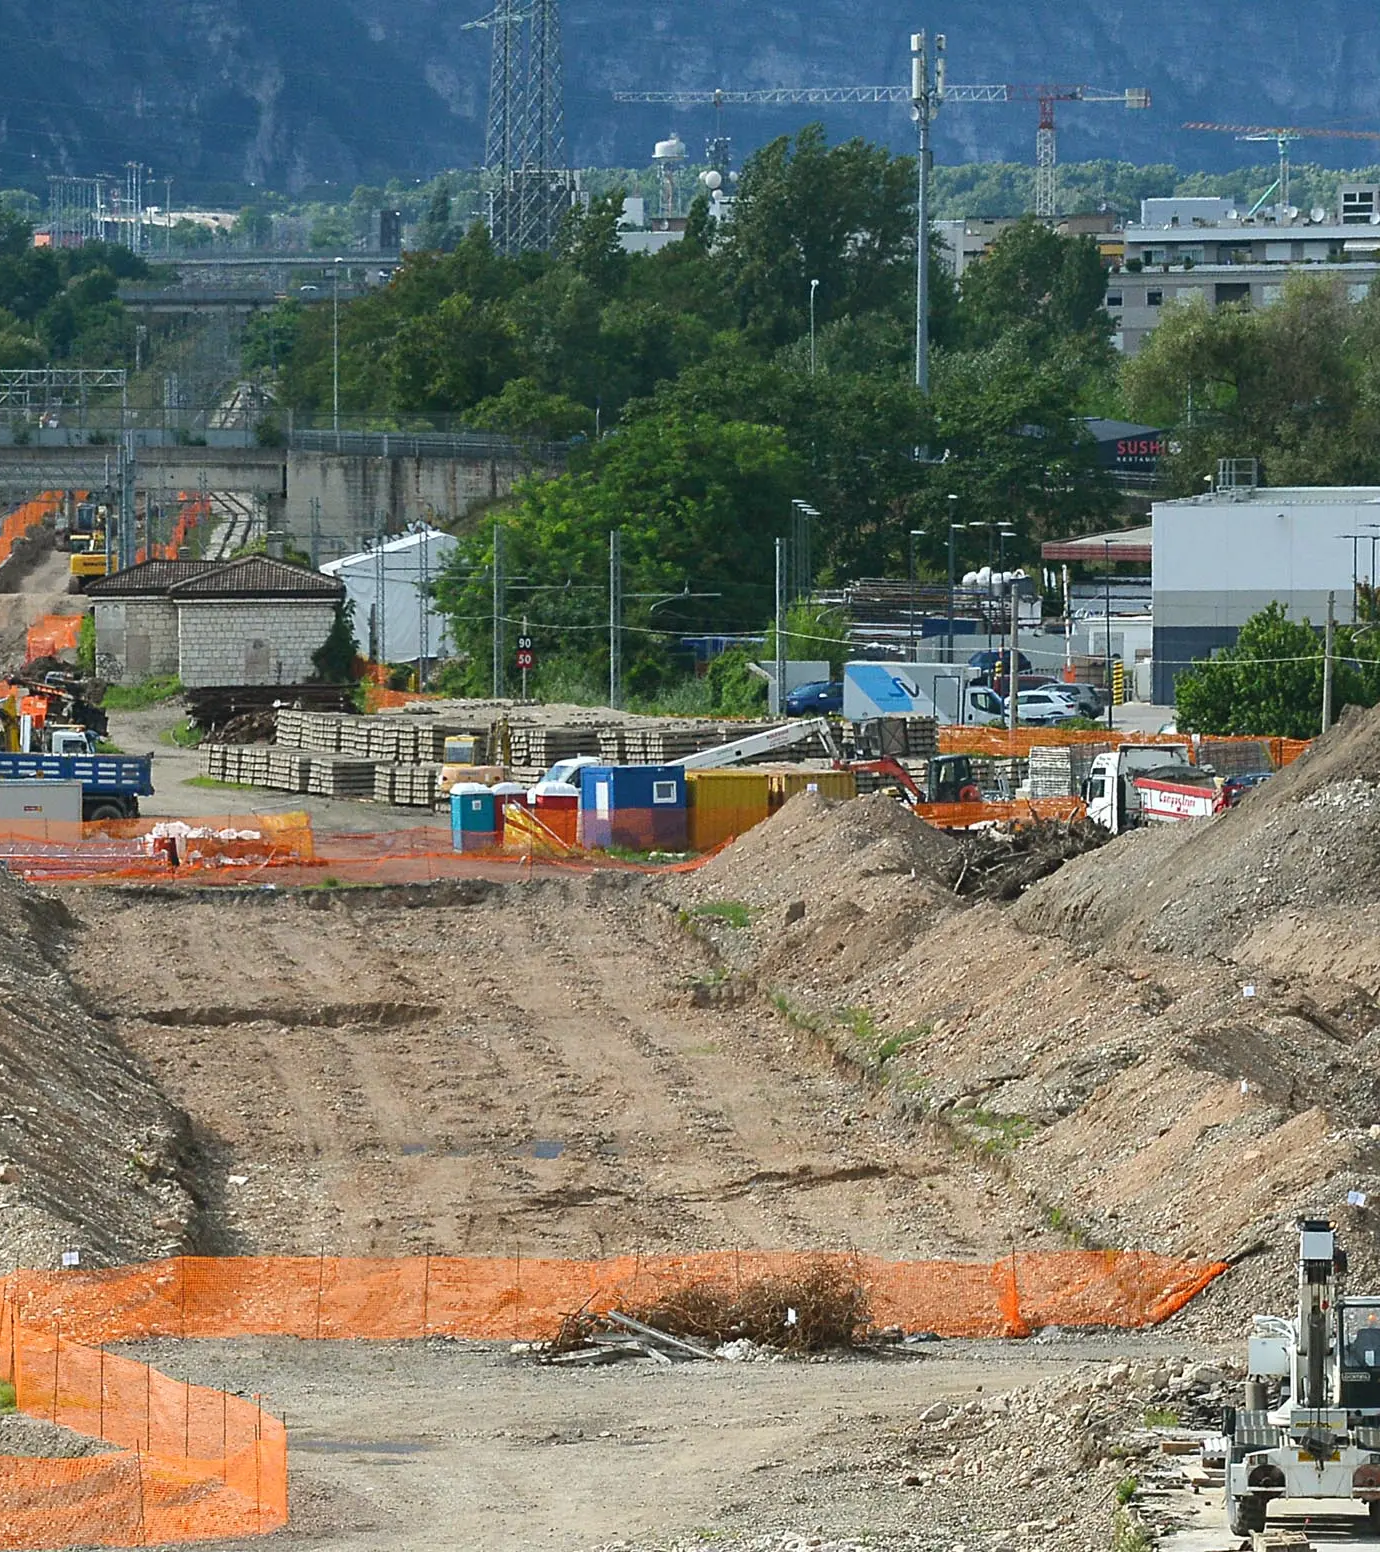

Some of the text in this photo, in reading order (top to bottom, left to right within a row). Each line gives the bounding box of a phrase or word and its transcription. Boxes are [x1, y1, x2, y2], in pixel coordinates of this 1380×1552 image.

[1117, 441, 1166, 455] SUSHI
[518, 638, 531, 648] 90
[518, 654, 531, 664] 50
